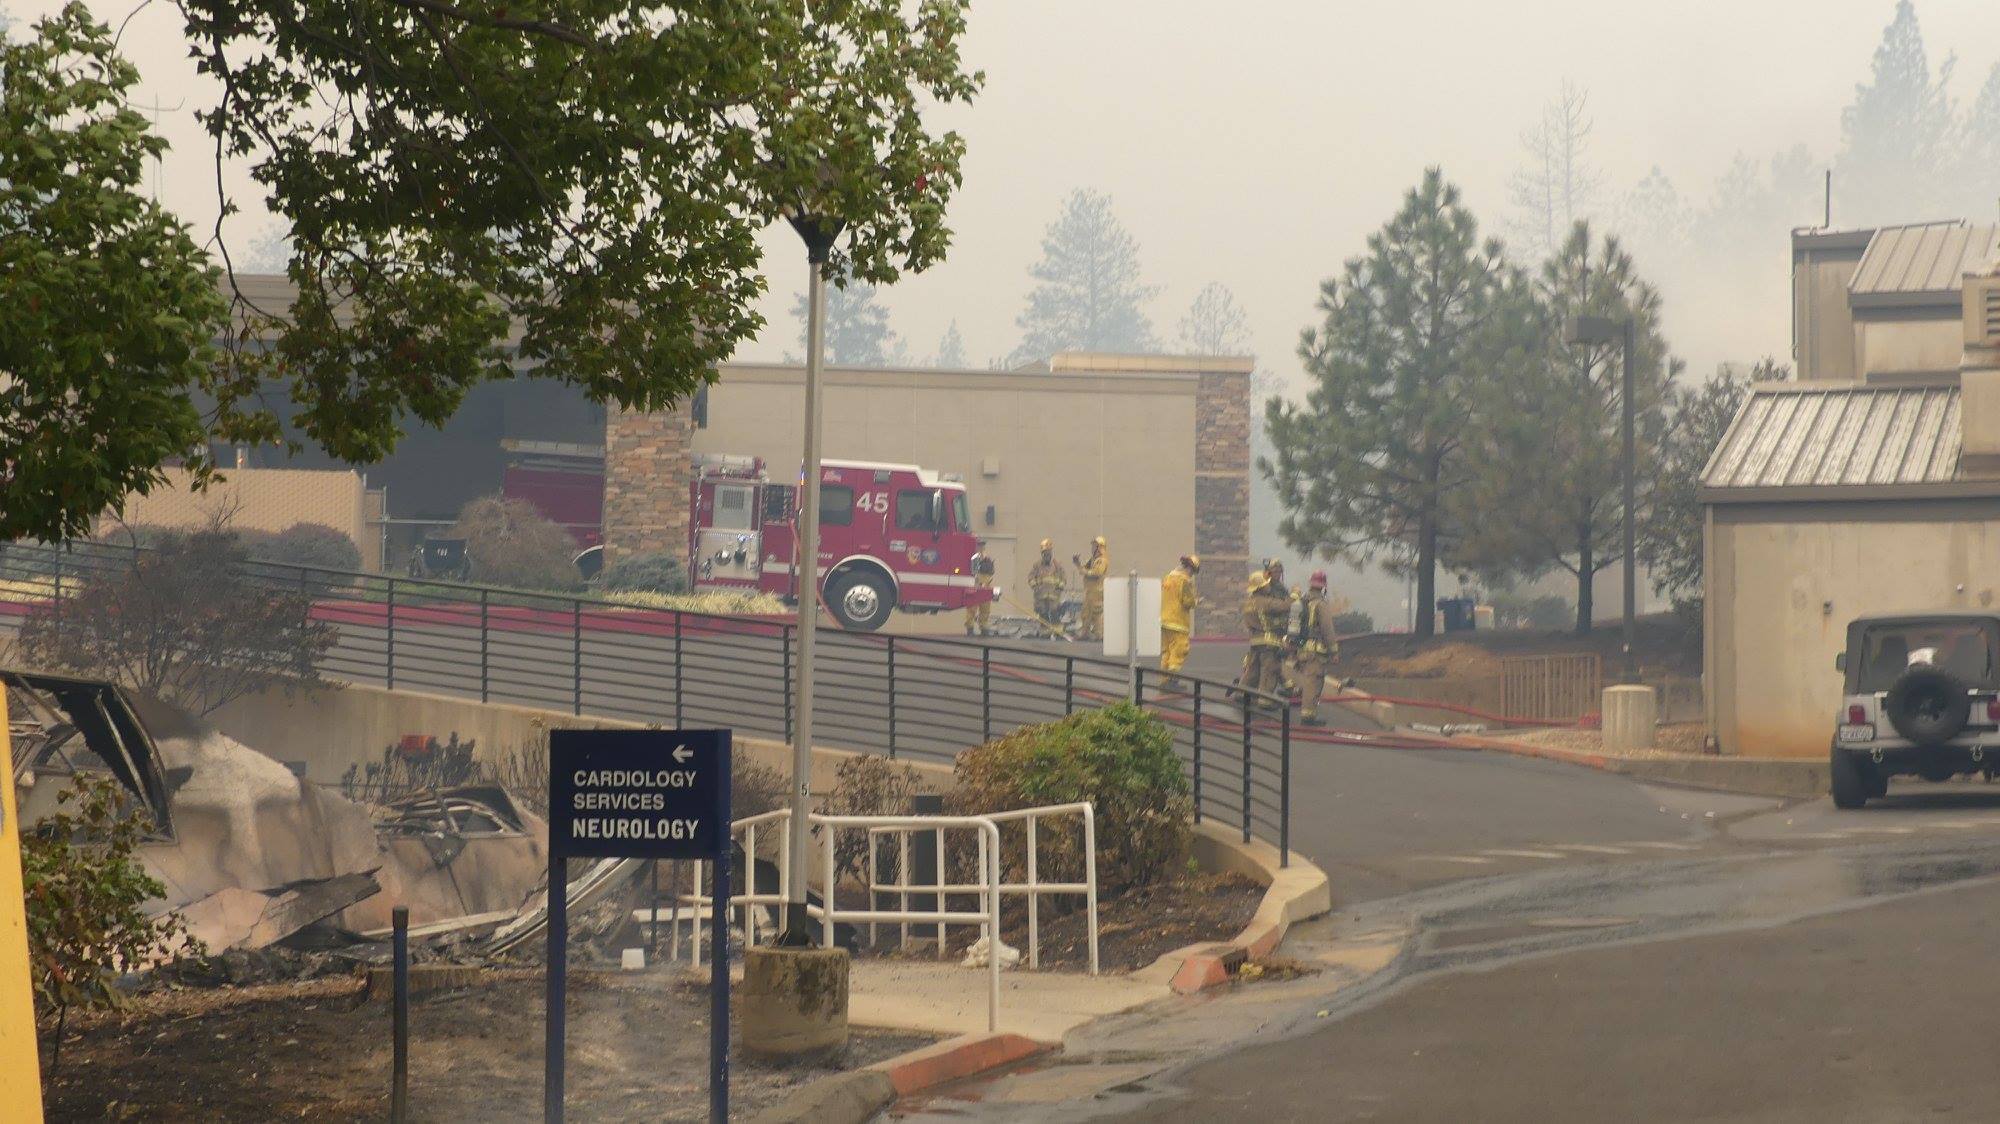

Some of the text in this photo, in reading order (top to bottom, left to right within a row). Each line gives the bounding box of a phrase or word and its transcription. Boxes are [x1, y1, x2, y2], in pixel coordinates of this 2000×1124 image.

[856, 491, 889, 513] 45
[573, 770, 697, 788] CARDIOLOGY
[573, 793, 665, 810] SERVICES
[572, 818, 700, 840] NEUROLOGY
